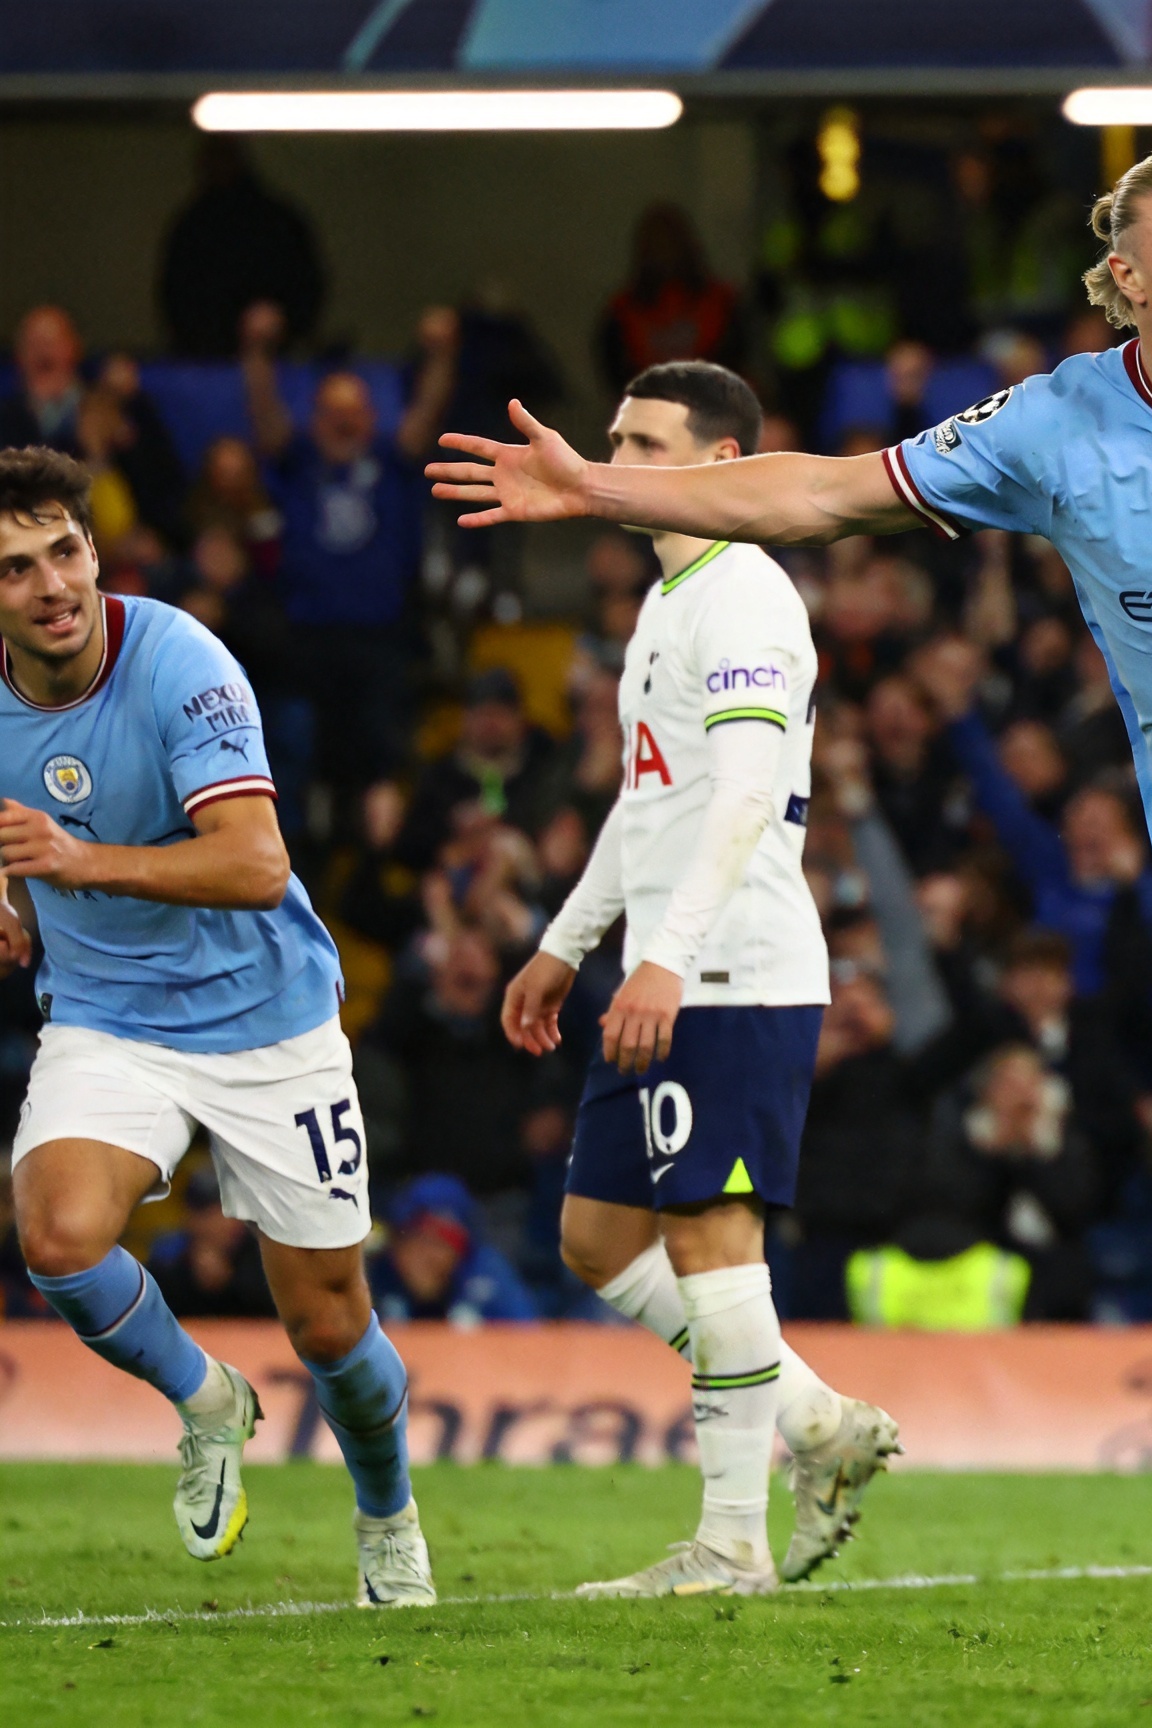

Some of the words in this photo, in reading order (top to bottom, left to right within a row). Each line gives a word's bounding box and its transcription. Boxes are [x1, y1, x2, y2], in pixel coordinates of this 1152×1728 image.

[706, 657, 787, 694] cinch
[293, 1097, 362, 1184] 15
[639, 1080, 693, 1159] 10
